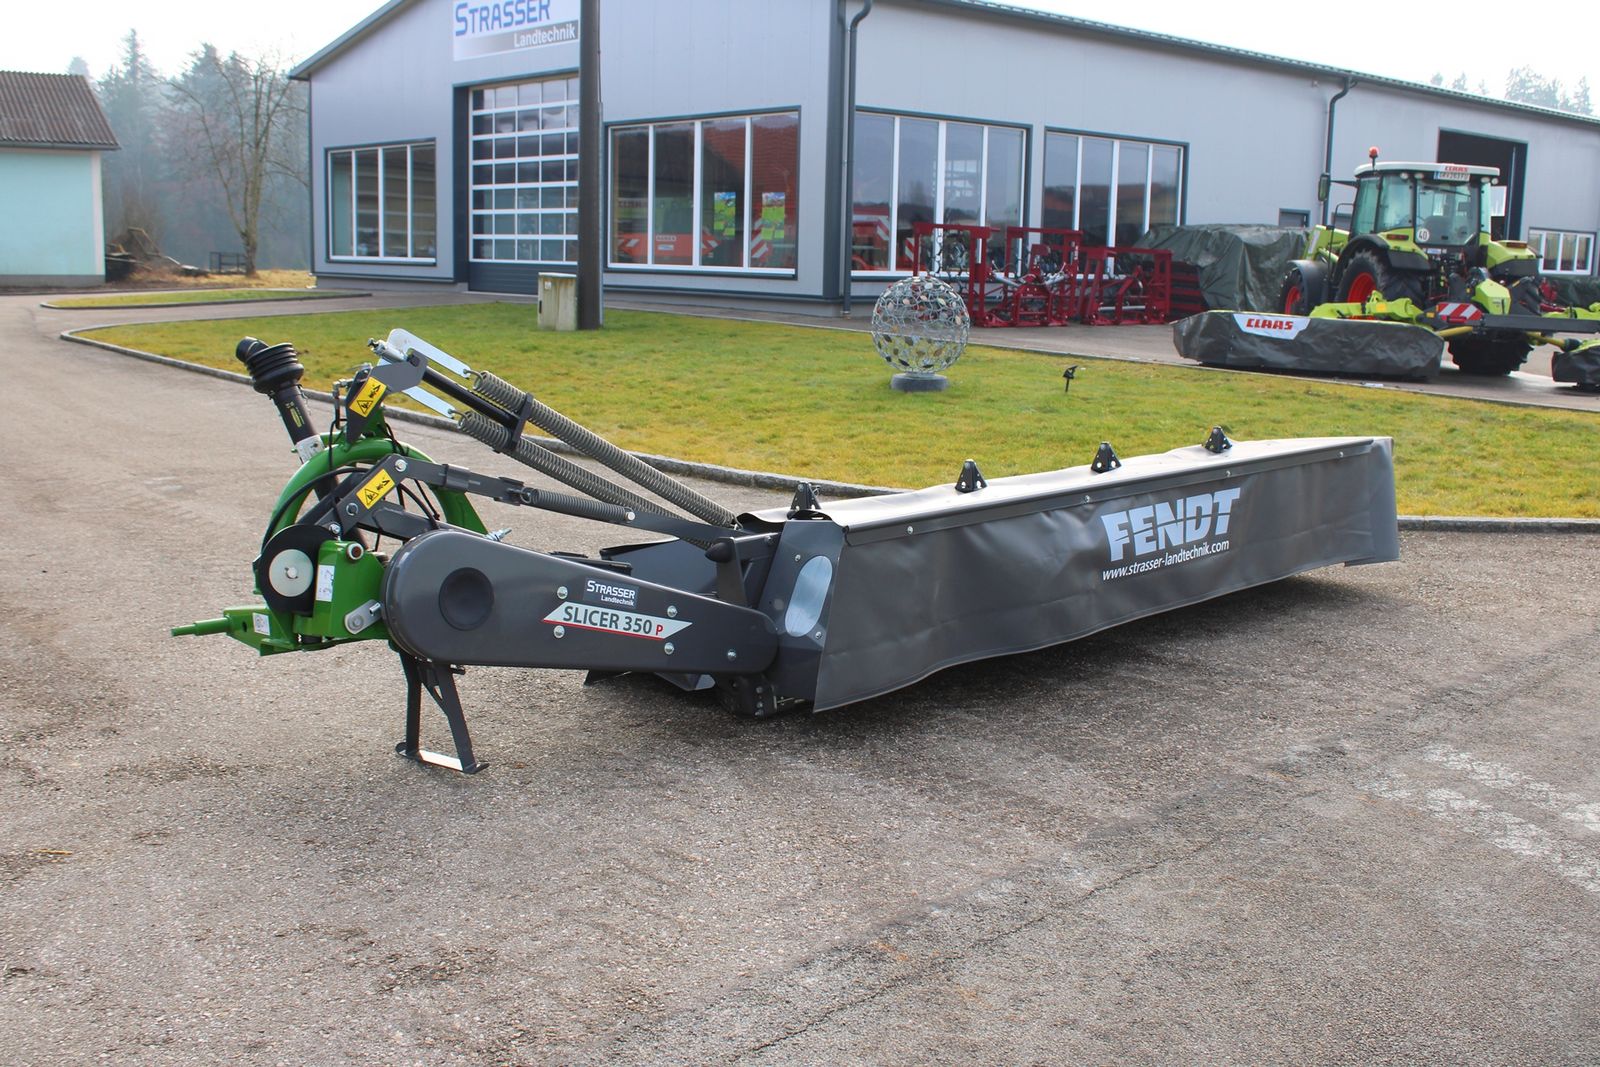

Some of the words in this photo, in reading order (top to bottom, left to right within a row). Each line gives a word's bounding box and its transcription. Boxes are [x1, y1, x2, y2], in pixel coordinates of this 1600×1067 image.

[455, 0, 550, 37] STRASSER
[513, 23, 576, 48] Landtechnik
[1418, 230, 1427, 240] 40
[1246, 318, 1294, 330] CLAAS
[1101, 487, 1241, 562] FENDT
[1102, 540, 1230, 581] www.strasser-landtechnik.com
[586, 580, 636, 600] STRASSER
[600, 595, 635, 607] Landtechnik
[563, 605, 620, 630] SLICER
[622, 616, 653, 634] 350
[655, 624, 664, 636] P
